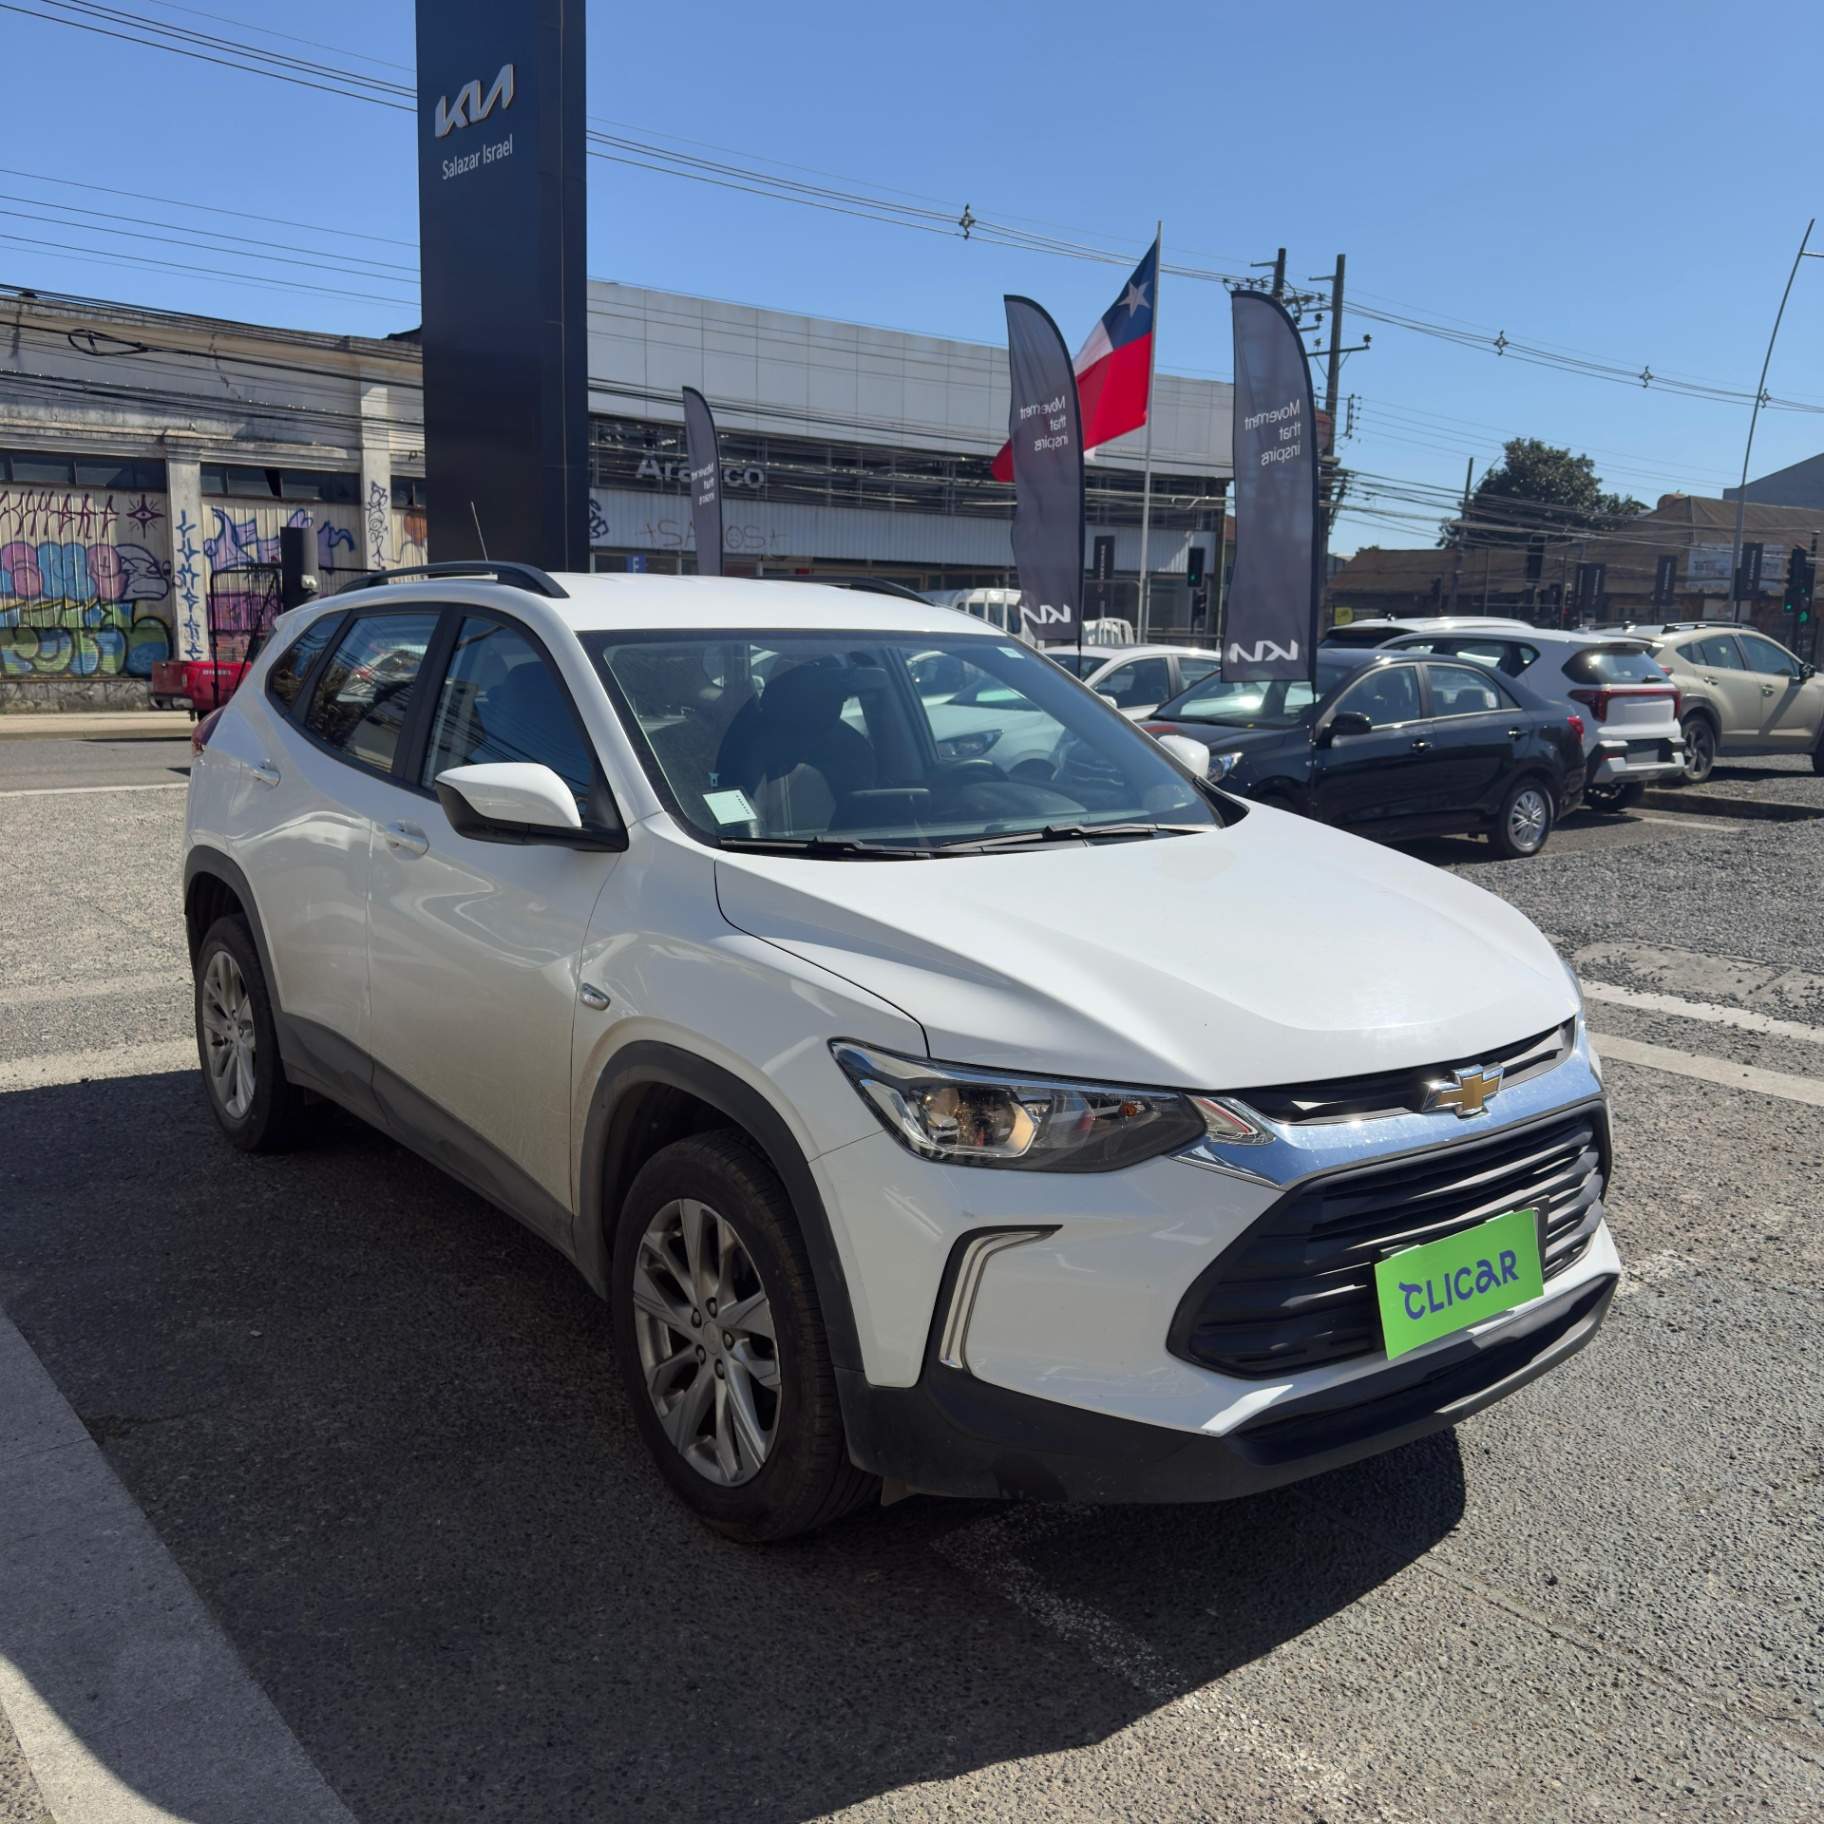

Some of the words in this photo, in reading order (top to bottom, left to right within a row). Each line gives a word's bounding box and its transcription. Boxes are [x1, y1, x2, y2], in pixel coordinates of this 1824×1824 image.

[435, 64, 514, 137] KIA
[442, 152, 480, 180] Salazar
[483, 133, 513, 164] Israel
[635, 453, 765, 489] Araco
